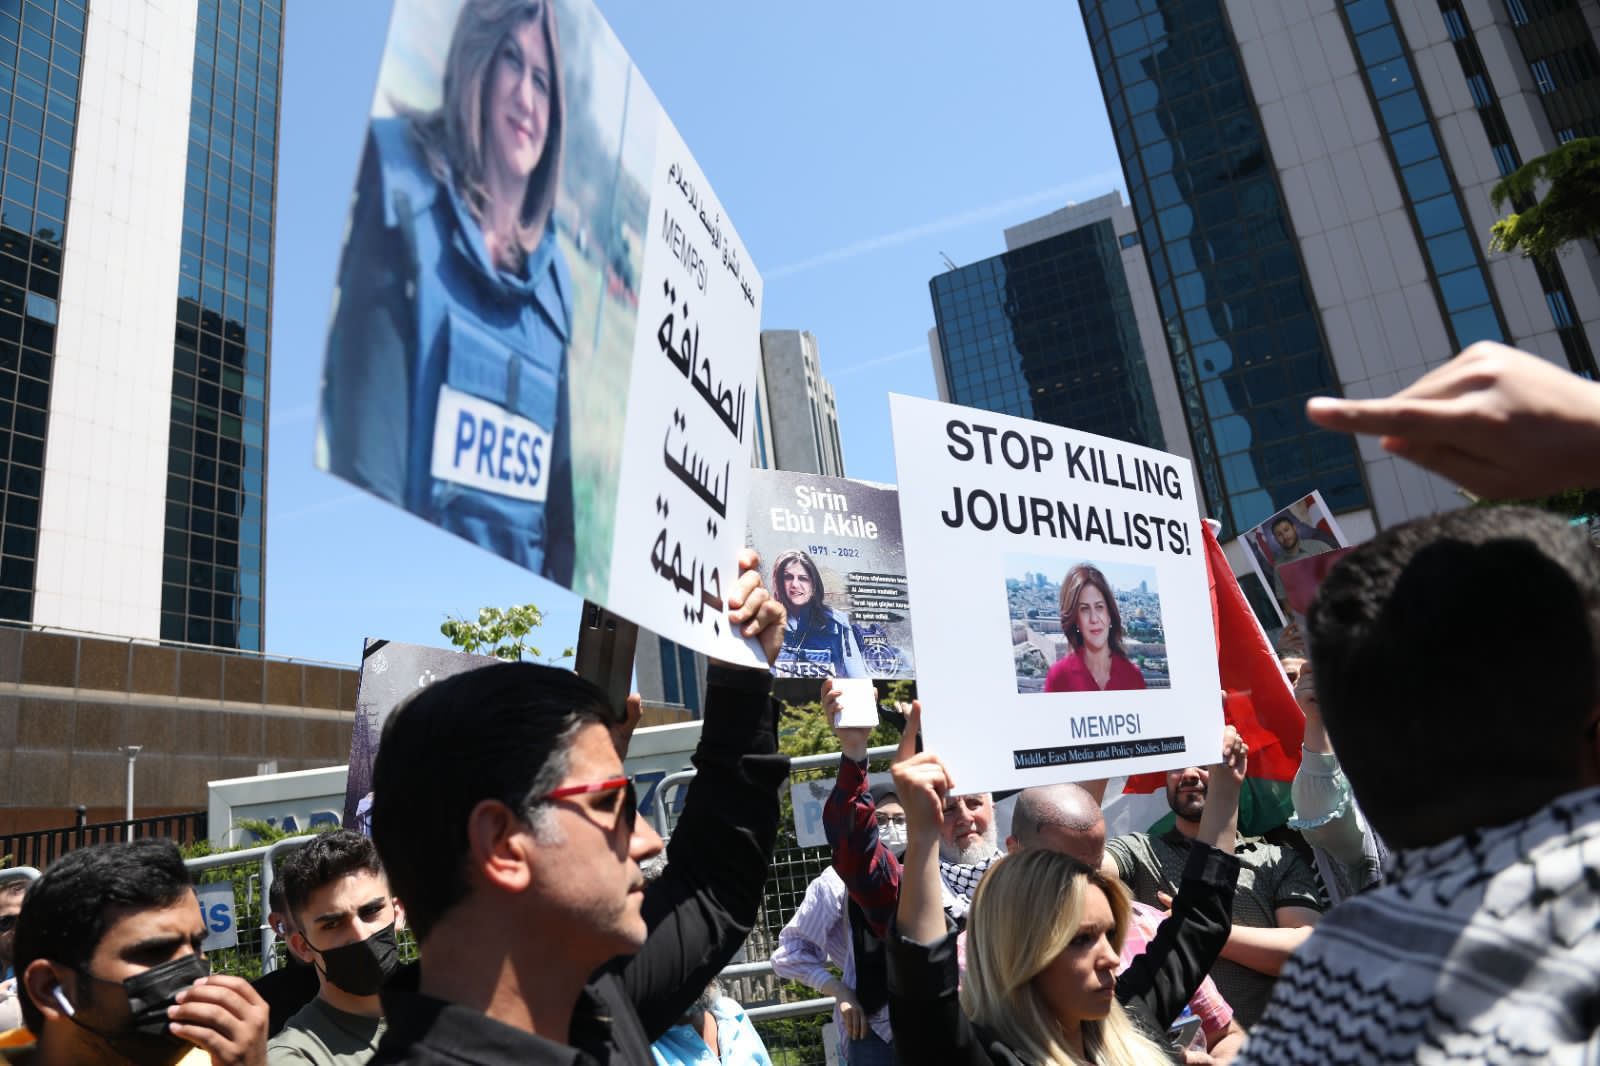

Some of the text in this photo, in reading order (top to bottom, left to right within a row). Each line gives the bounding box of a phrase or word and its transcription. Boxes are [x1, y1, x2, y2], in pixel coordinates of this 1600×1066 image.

[662, 208, 708, 296] MEMPSI
[657, 278, 746, 445] الصحافة
[454, 408, 543, 487] PRESS
[664, 407, 730, 540] ليست
[946, 419, 1182, 500] STOP KILLING
[795, 485, 848, 514] Şirin
[824, 512, 878, 539] Akile
[941, 487, 1191, 556] JOURNALISTS!
[650, 493, 723, 637] جريمة
[808, 545, 828, 556] 1971
[1014, 753, 1046, 767] Middle
[1050, 751, 1067, 763] East
[1068, 749, 1094, 761] Media
[1096, 747, 1109, 759] and
[1111, 745, 1133, 758] Policy
[1070, 713, 1141, 739] MEMPSI
